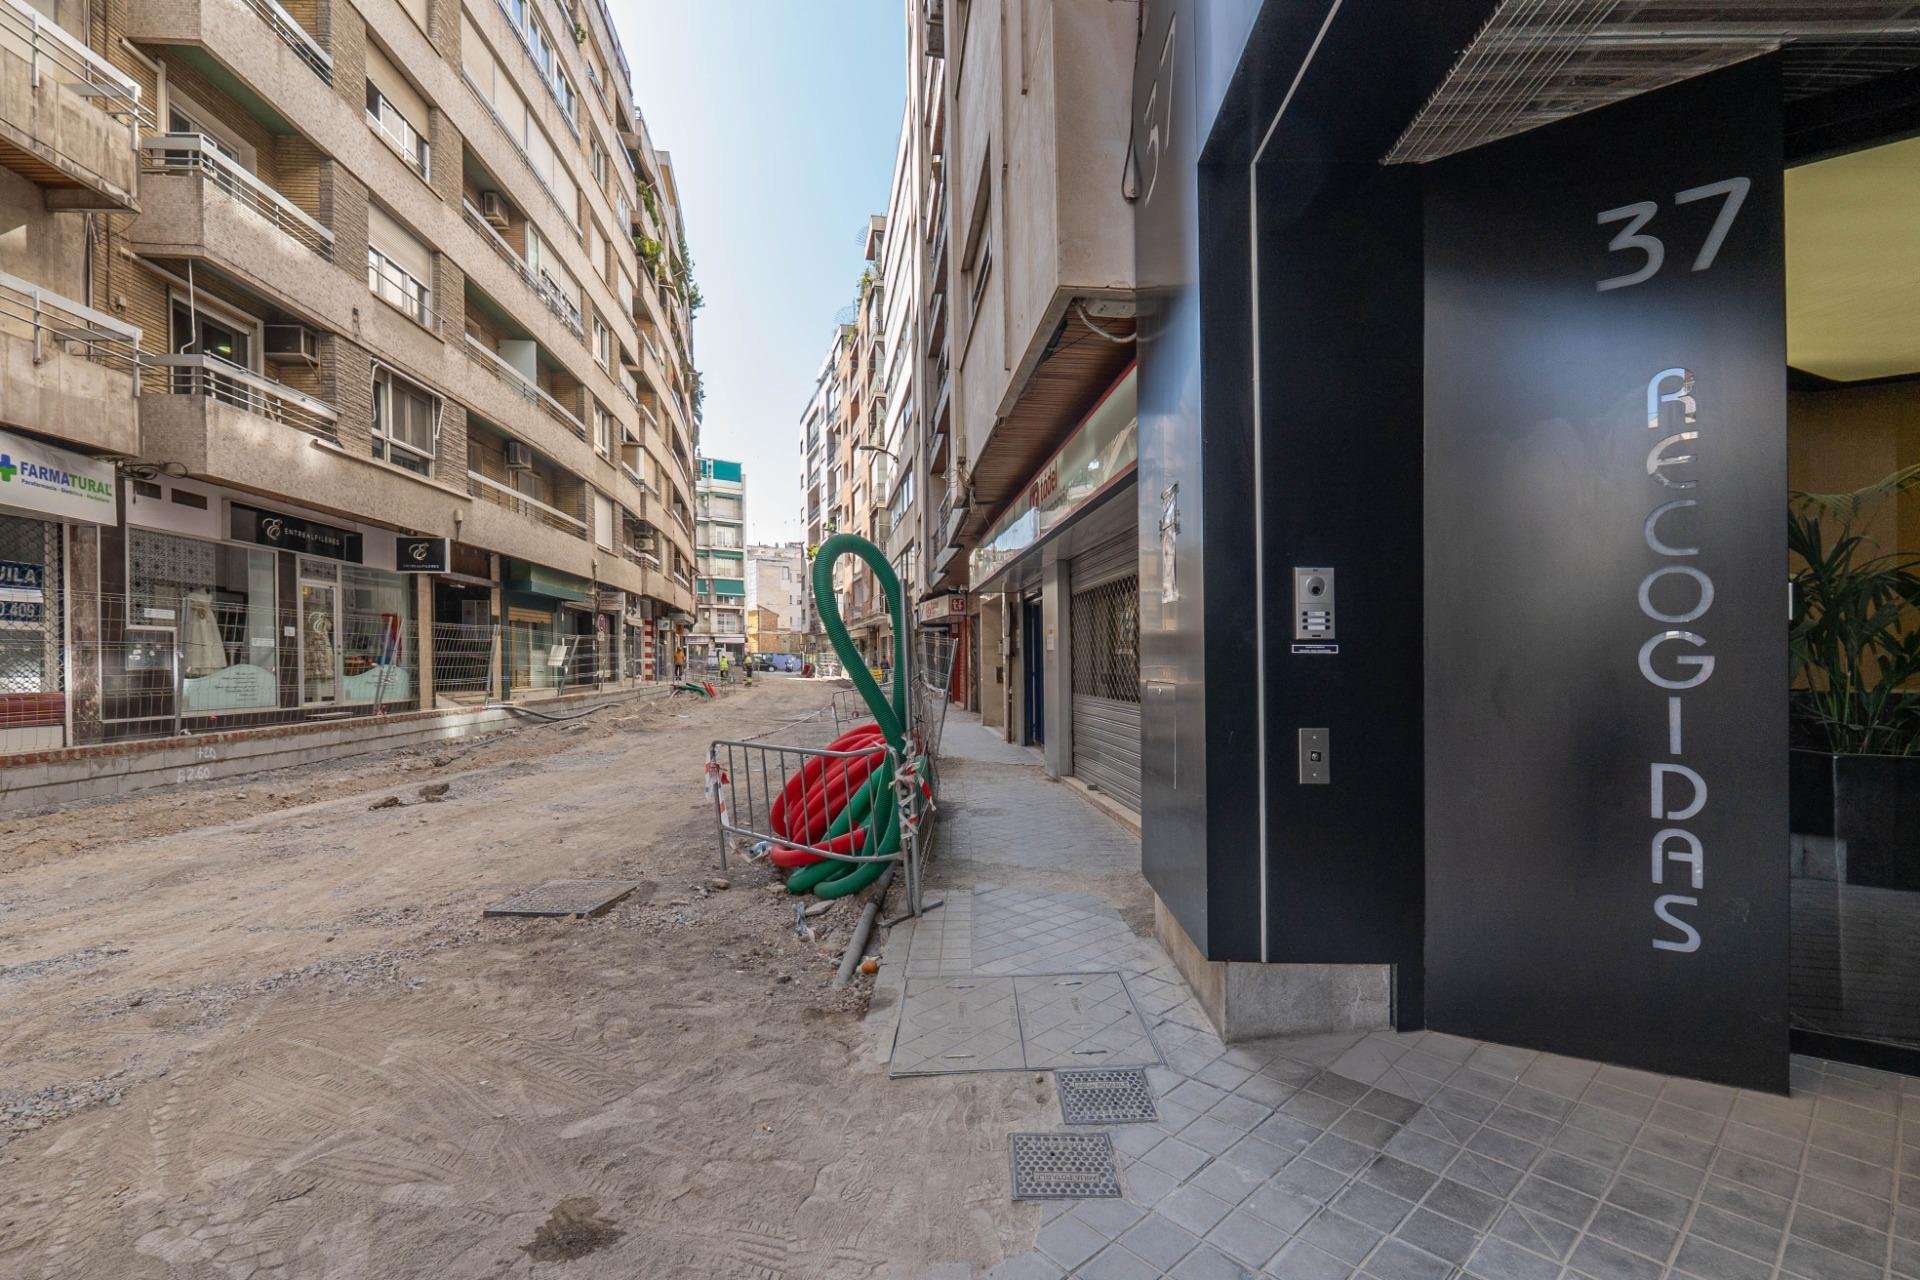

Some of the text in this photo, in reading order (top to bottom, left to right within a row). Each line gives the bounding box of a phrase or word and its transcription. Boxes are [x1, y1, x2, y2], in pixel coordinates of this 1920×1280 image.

[1596, 176, 1751, 292] 37
[20, 461, 113, 497] FARMATURAL
[1637, 367, 1715, 953] RECOGIDAS
